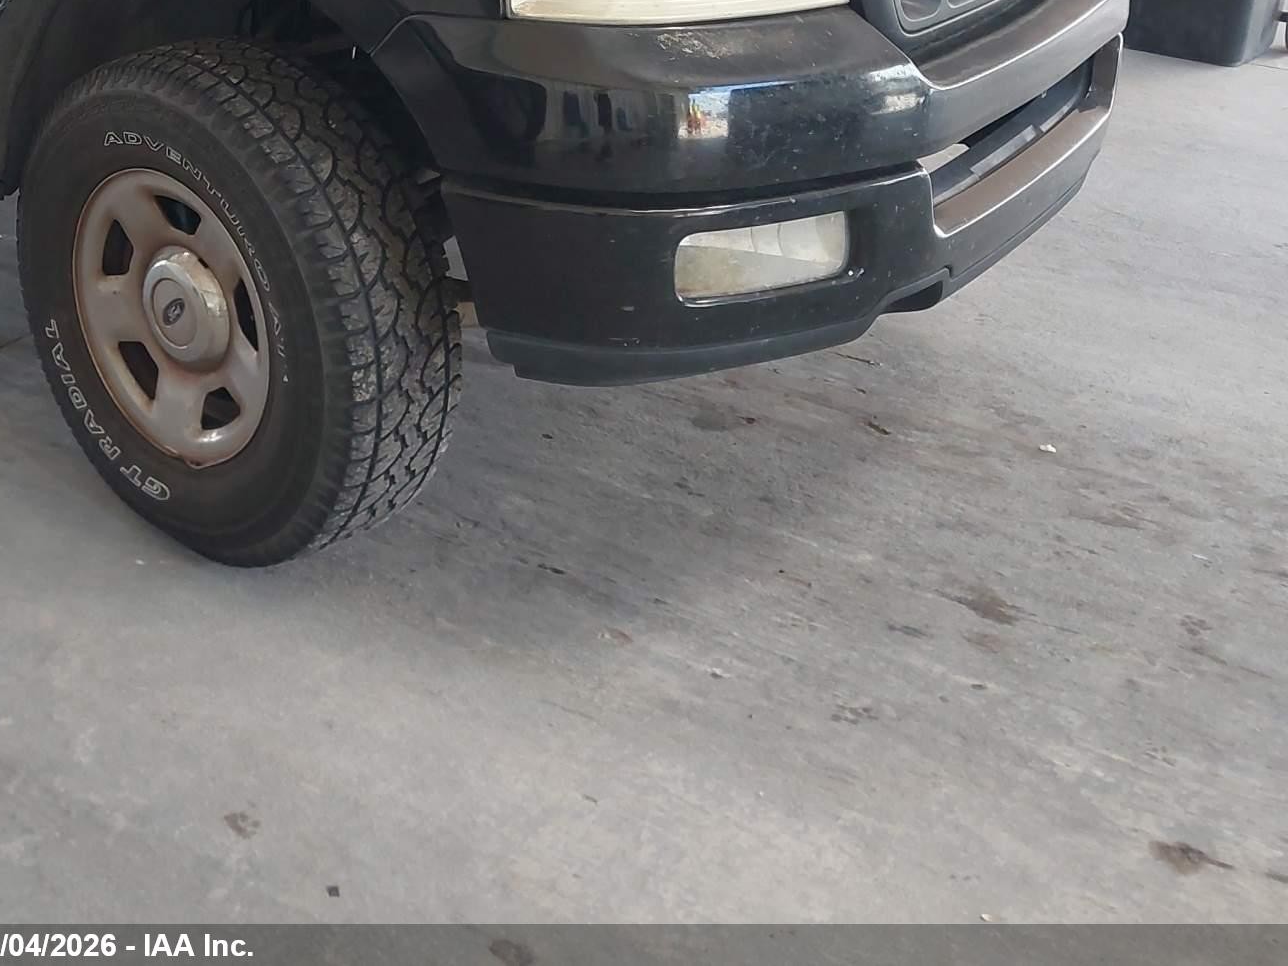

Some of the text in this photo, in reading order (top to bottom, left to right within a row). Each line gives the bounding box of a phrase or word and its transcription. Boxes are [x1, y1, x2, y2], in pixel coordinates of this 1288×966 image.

[103, 130, 271, 293] ADVENTURO
[44, 318, 171, 501] GT RADIAL
